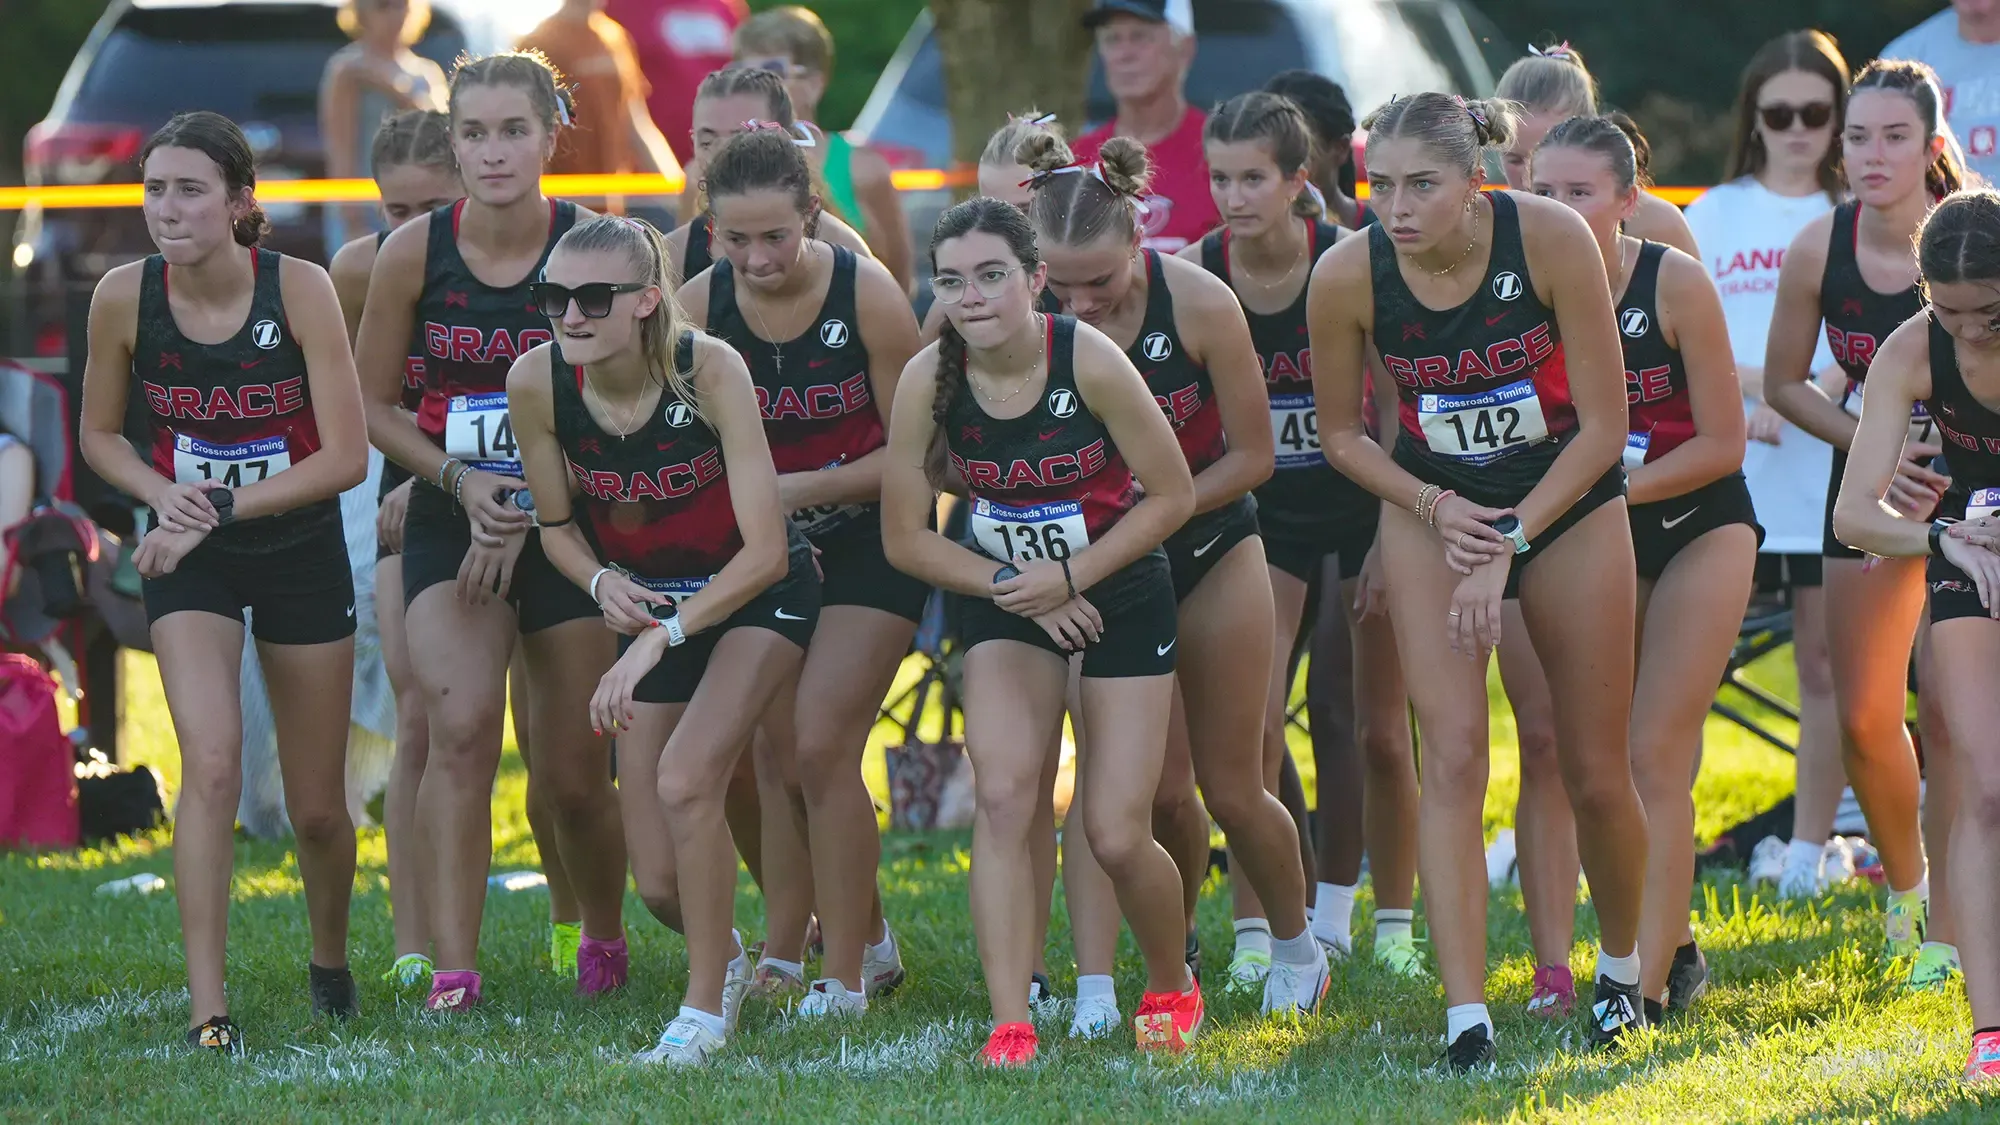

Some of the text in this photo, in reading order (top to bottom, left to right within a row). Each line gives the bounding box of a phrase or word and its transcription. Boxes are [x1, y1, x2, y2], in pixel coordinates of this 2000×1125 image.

[1384, 320, 1554, 388] GRACE
[143, 375, 303, 420] GRACE
[1438, 383, 1532, 409] Crossroads Timing
[192, 439, 285, 457] Crossroads Timing
[1445, 407, 1526, 452] 142
[569, 445, 723, 502] GRACE
[949, 437, 1107, 489] GRACE
[990, 501, 1078, 519] Crossroads Timing
[994, 522, 1072, 562] 136
[684, 580, 708, 588] Timi
